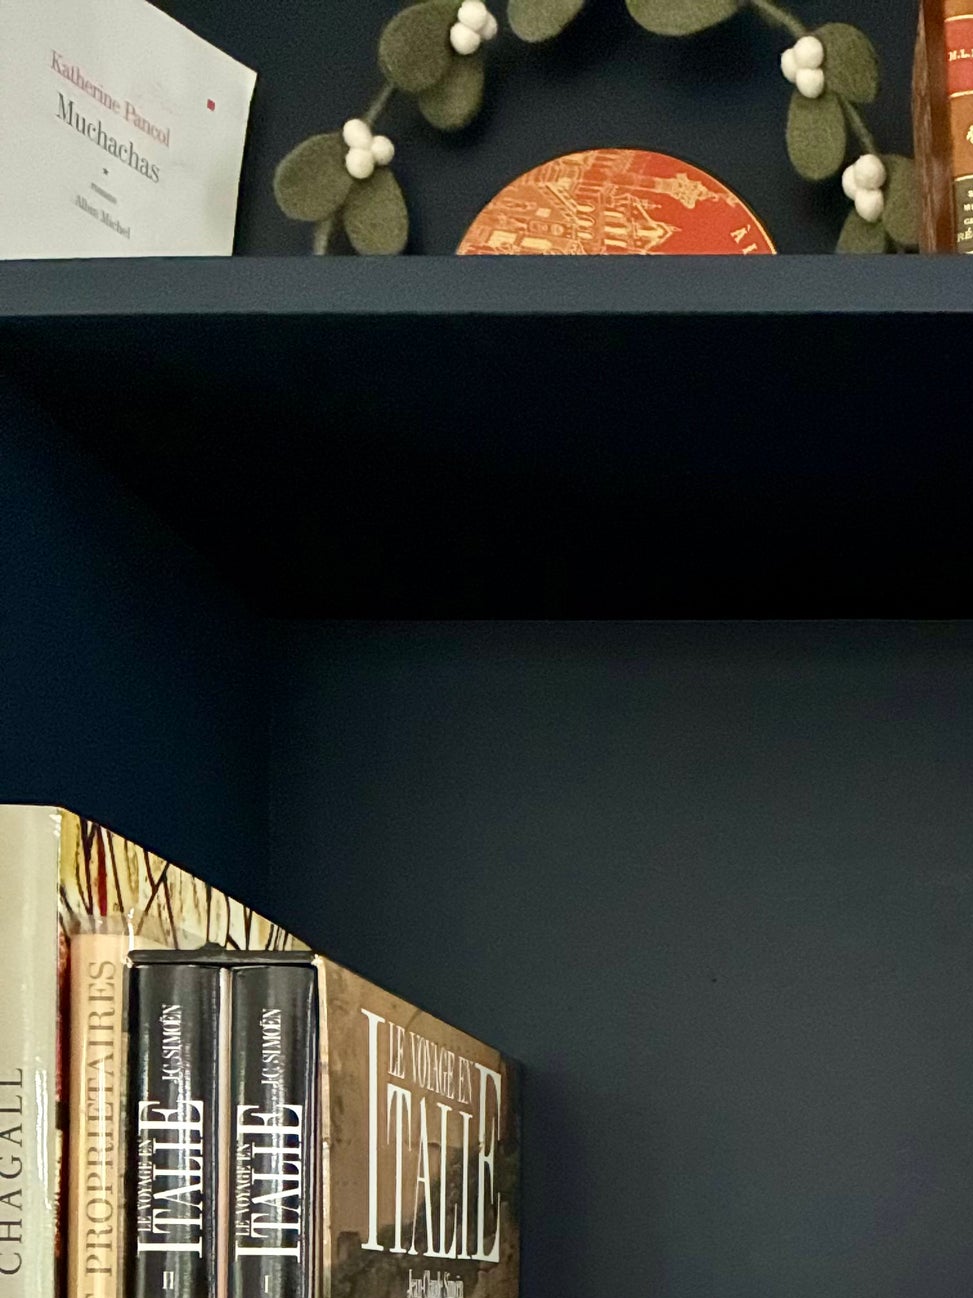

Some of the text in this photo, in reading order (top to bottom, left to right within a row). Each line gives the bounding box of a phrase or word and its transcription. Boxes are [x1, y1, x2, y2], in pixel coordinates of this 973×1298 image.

[50, 50, 171, 148] Katherine Pancol
[56, 92, 161, 183] Muchachas
[387, 1020, 405, 1080] LE
[409, 1031, 455, 1101] VOYAGE
[85, 960, 117, 1277] PROPRIETAIRES
[361, 1008, 502, 1263] ITALIE
[0, 1067, 23, 1276] CHAGALL
[137, 1100, 204, 1258] ITALIE
[137, 1139, 152, 1231] LE VOYAGE EN
[235, 1104, 303, 1263] ITALIE
[235, 1143, 251, 1236] LE VOYAGE EN
[162, 1271, 174, 1290] II
